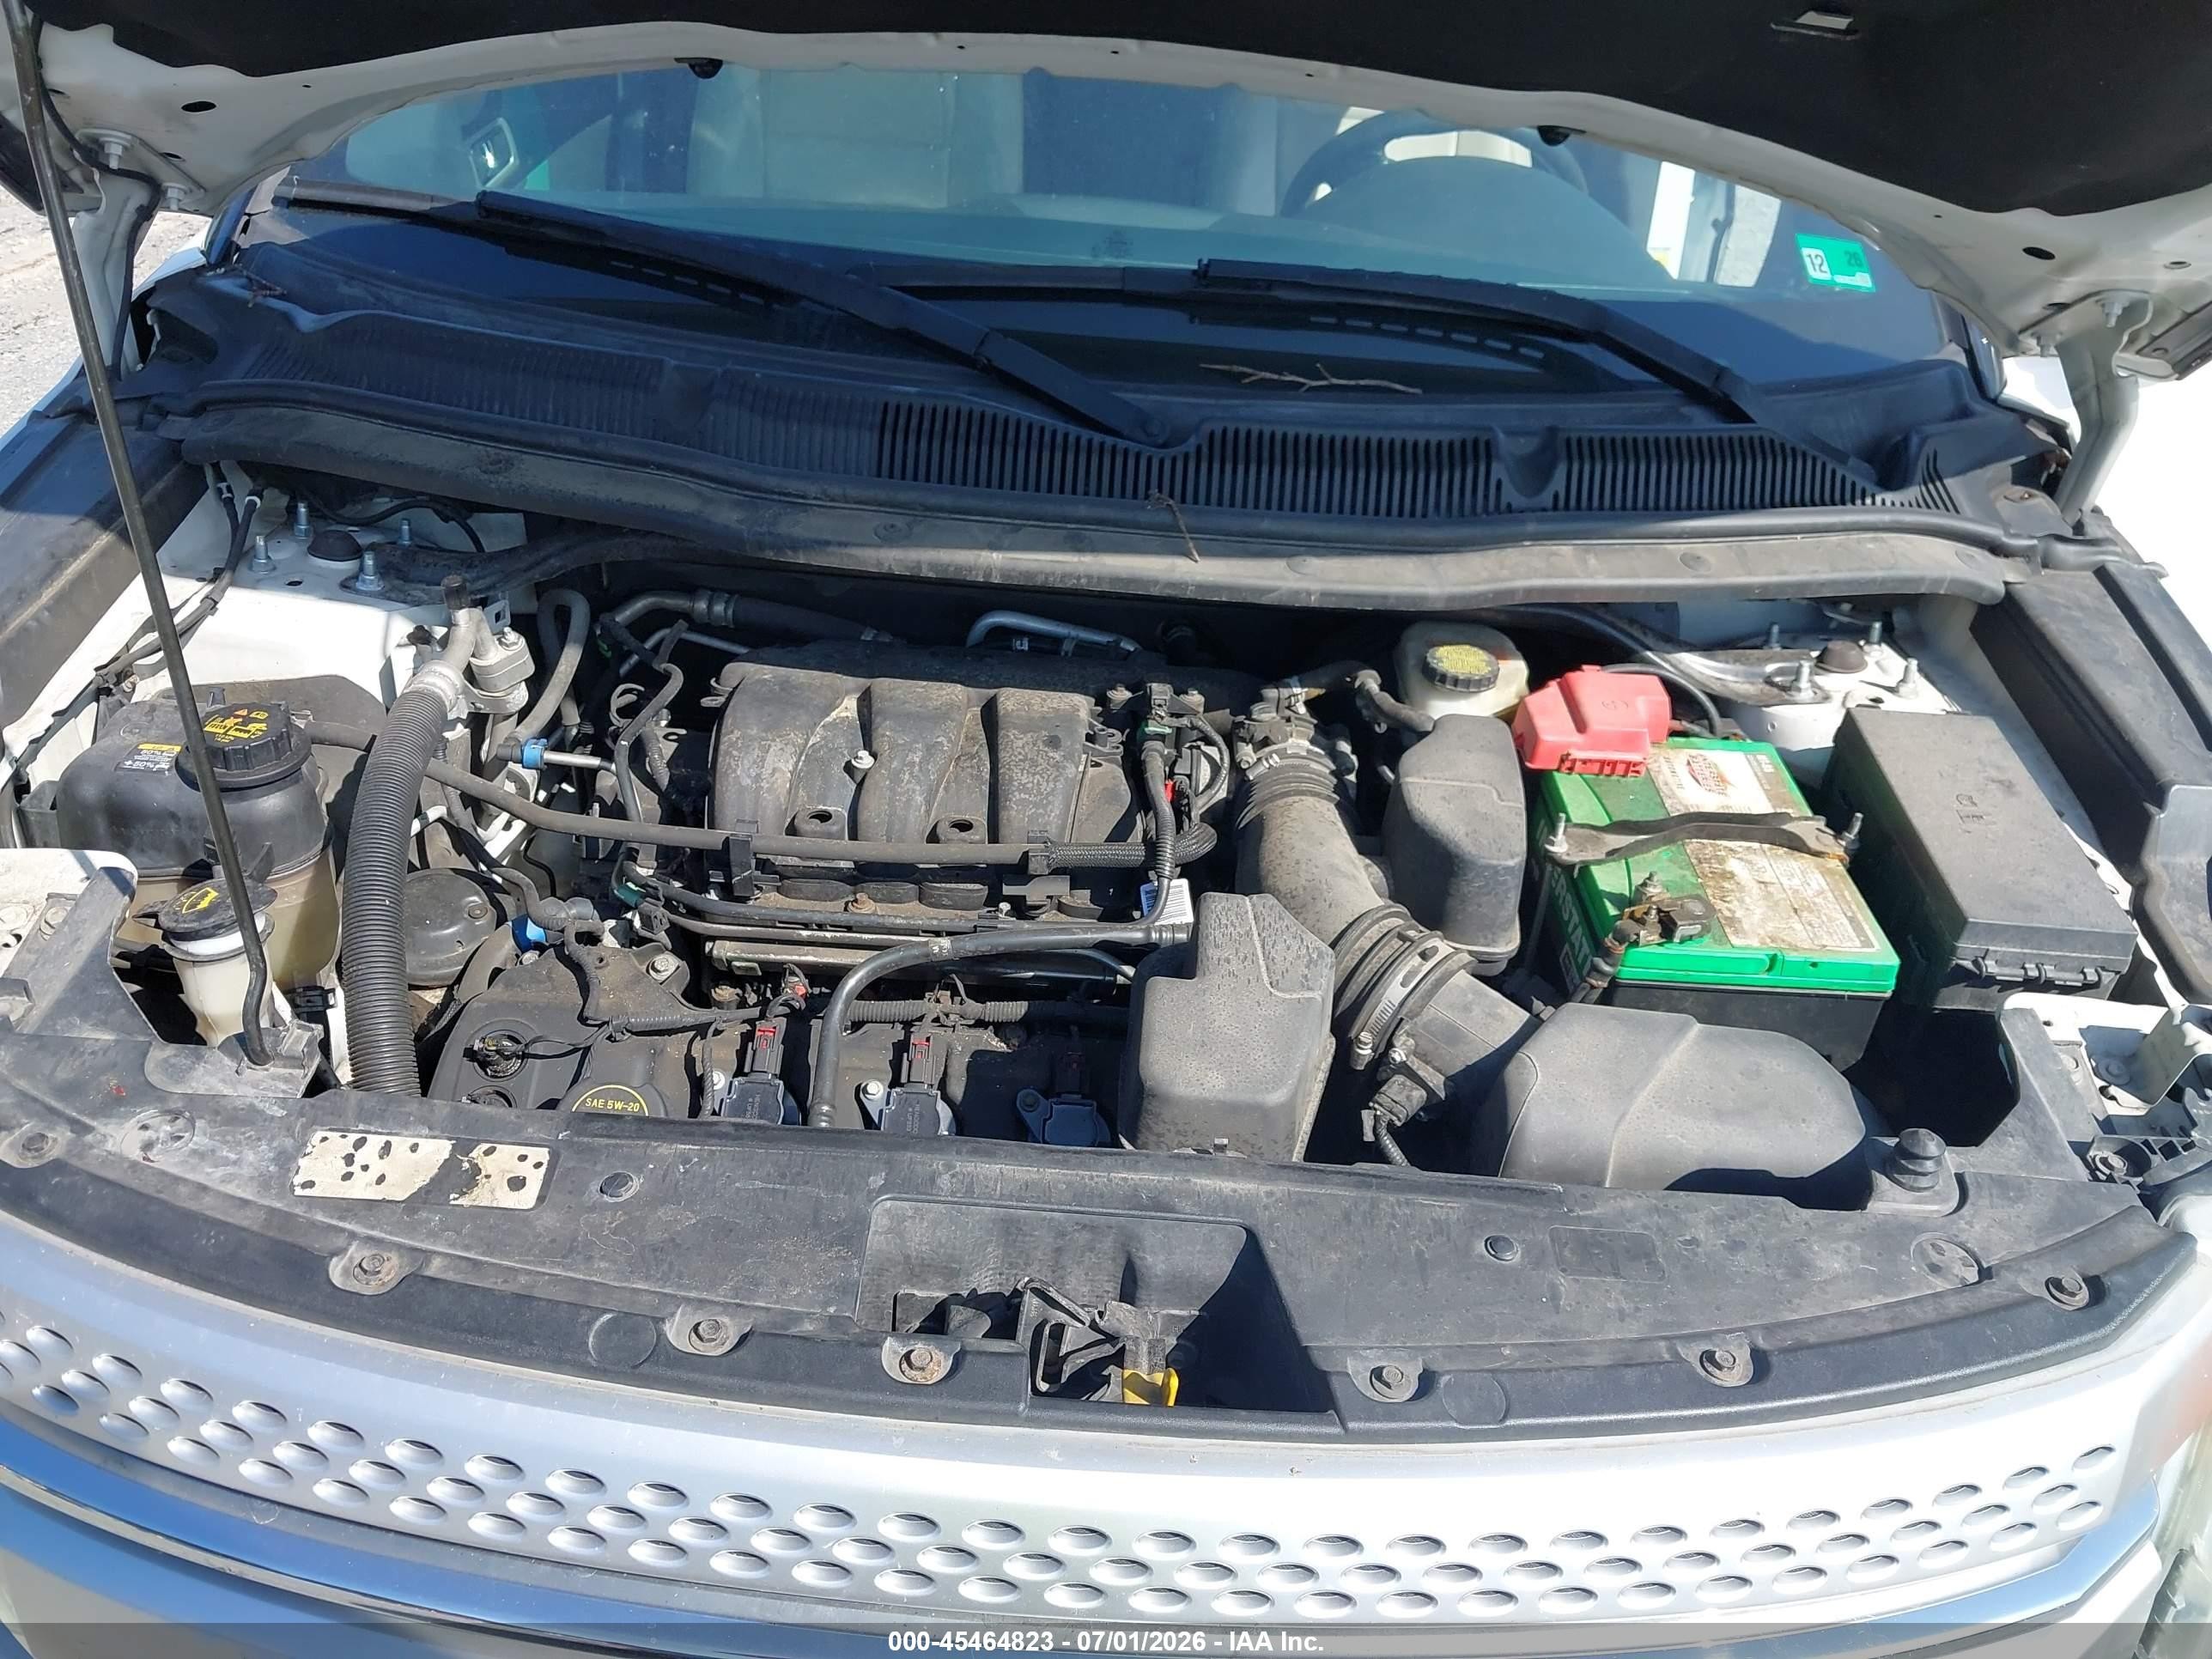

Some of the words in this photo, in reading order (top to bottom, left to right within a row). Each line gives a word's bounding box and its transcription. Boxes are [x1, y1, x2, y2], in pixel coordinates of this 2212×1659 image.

[1806, 253, 1828, 274] 12
[1843, 250, 1864, 268] 26
[585, 1097, 605, 1109] SAE
[606, 1100, 640, 1112] 5W-20
